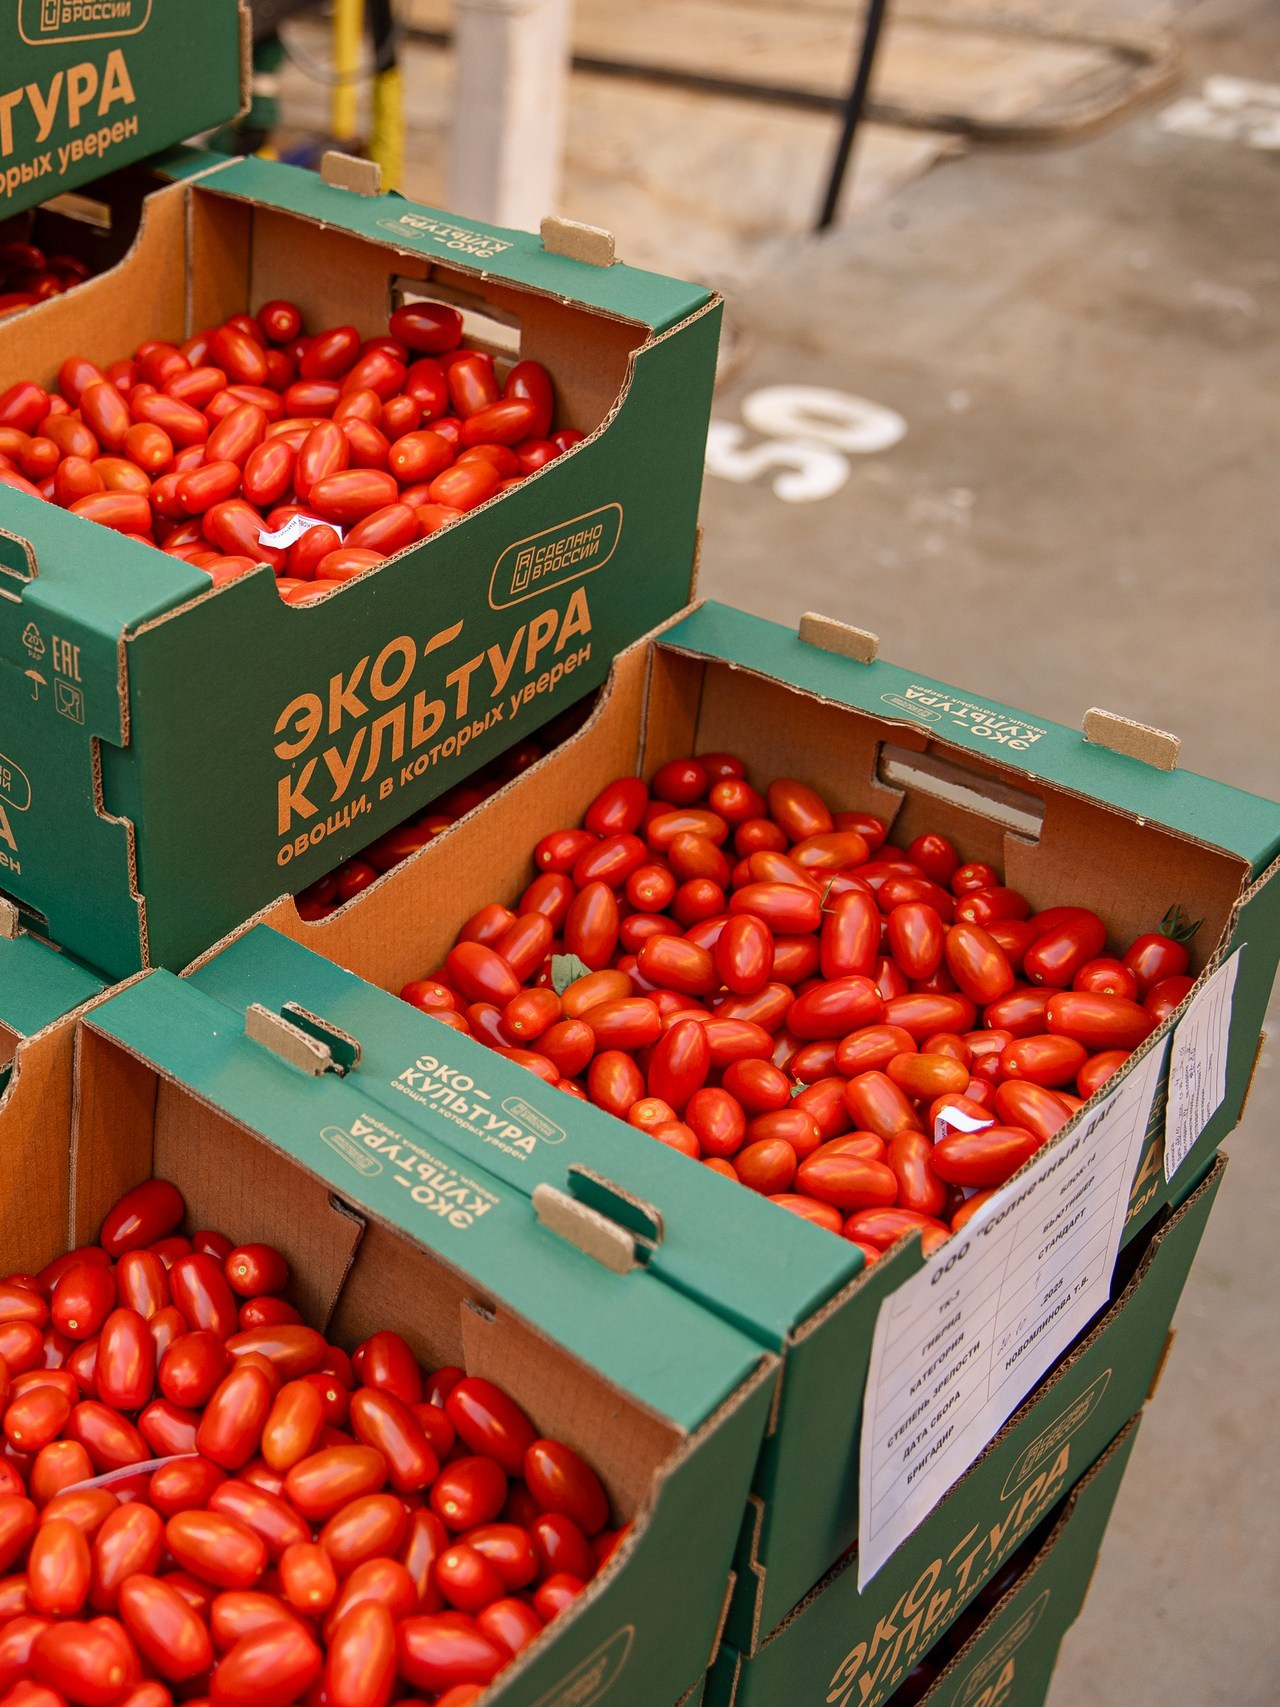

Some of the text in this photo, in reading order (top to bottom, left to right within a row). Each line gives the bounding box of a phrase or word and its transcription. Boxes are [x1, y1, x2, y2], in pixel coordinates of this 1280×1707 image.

[58, 115, 138, 174] уверен
[399, 215, 508, 253] КУЛЬТУРА
[535, 523, 602, 563] СДЕЛАНО
[542, 540, 600, 578] РОССИИ
[273, 619, 464, 760] ЭКО-
[278, 586, 592, 836] КУЛЬТУРА
[904, 688, 1042, 743] КУЛЬТУРА
[277, 642, 591, 867] овощи, в которых уверен
[952, 719, 1030, 751] ЭКО-
[415, 1055, 492, 1101] ЭКО-
[398, 1067, 538, 1154] КУЛЬТУРА
[437, 1106, 484, 1138] которых
[483, 1132, 527, 1162] уверен
[349, 1118, 492, 1217] КУЛЬТУРА
[393, 1174, 474, 1230] ЭКО-
[1038, 1207, 1086, 1260] СТАНДАРТ
[931, 1242, 970, 1286] ООО
[922, 1311, 962, 1357] ГИБРИД
[1005, 1293, 1071, 1371] НОВОМЛИНОВА
[887, 1340, 980, 1448] СТЕПЕНЬ ЗРЕЛОСТИ
[909, 1332, 964, 1397] КАТЕГОРИЯ
[902, 1390, 962, 1462] ДАТА СБОРА
[906, 1423, 955, 1485] БРИГАДИР
[825, 1522, 980, 1703] ЭКО-
